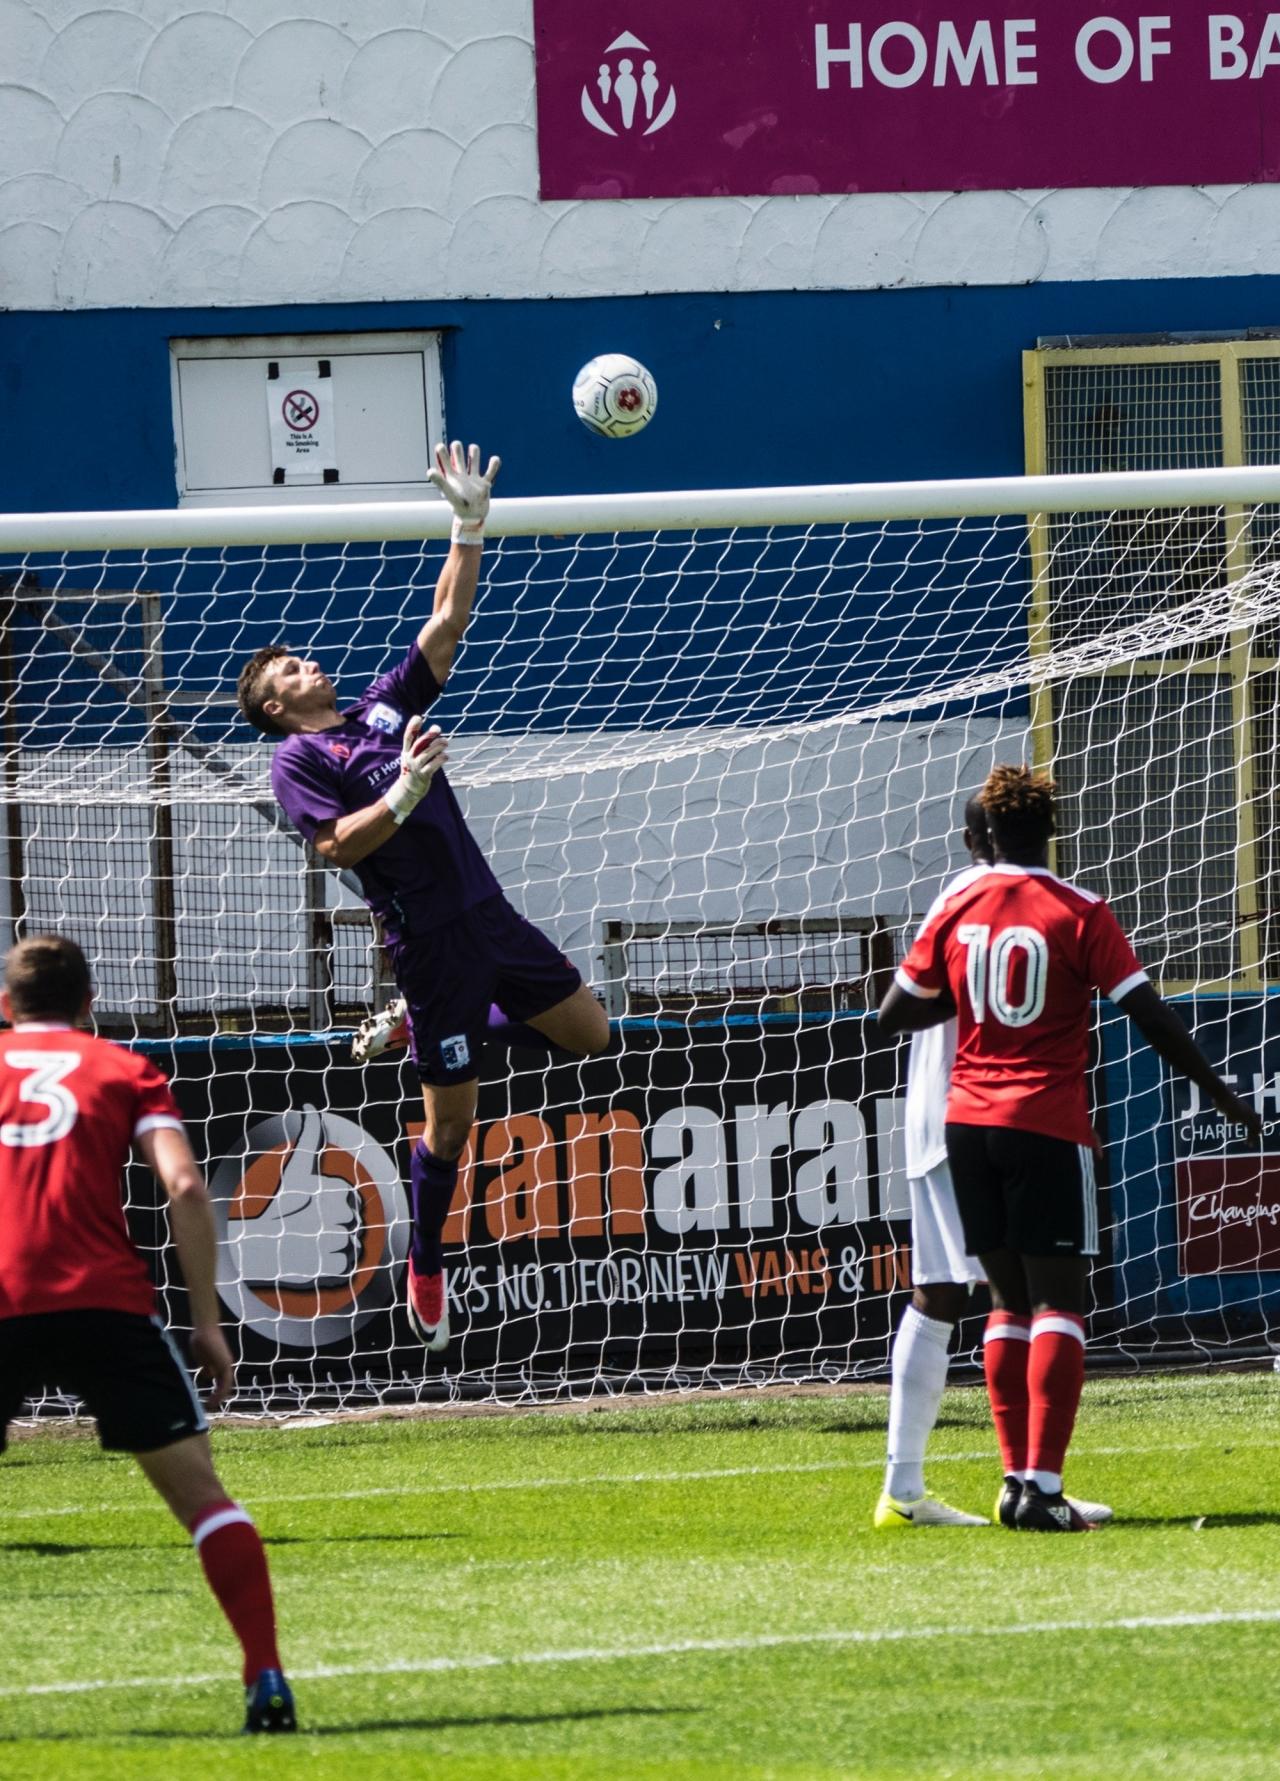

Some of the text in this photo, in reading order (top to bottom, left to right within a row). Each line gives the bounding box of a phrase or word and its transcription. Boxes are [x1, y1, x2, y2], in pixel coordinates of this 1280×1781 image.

[814, 19, 1038, 90] HOME
[1074, 16, 1171, 84] OF
[957, 924, 1049, 1028] 10
[0, 1050, 82, 1148] 3
[1180, 1120, 1274, 1142] CHARTED
[498, 1262, 568, 1312] NO.1
[580, 1257, 644, 1306] FOR
[651, 1252, 730, 1304] NEW
[735, 1247, 833, 1298] VANS
[838, 1245, 866, 1293] &
